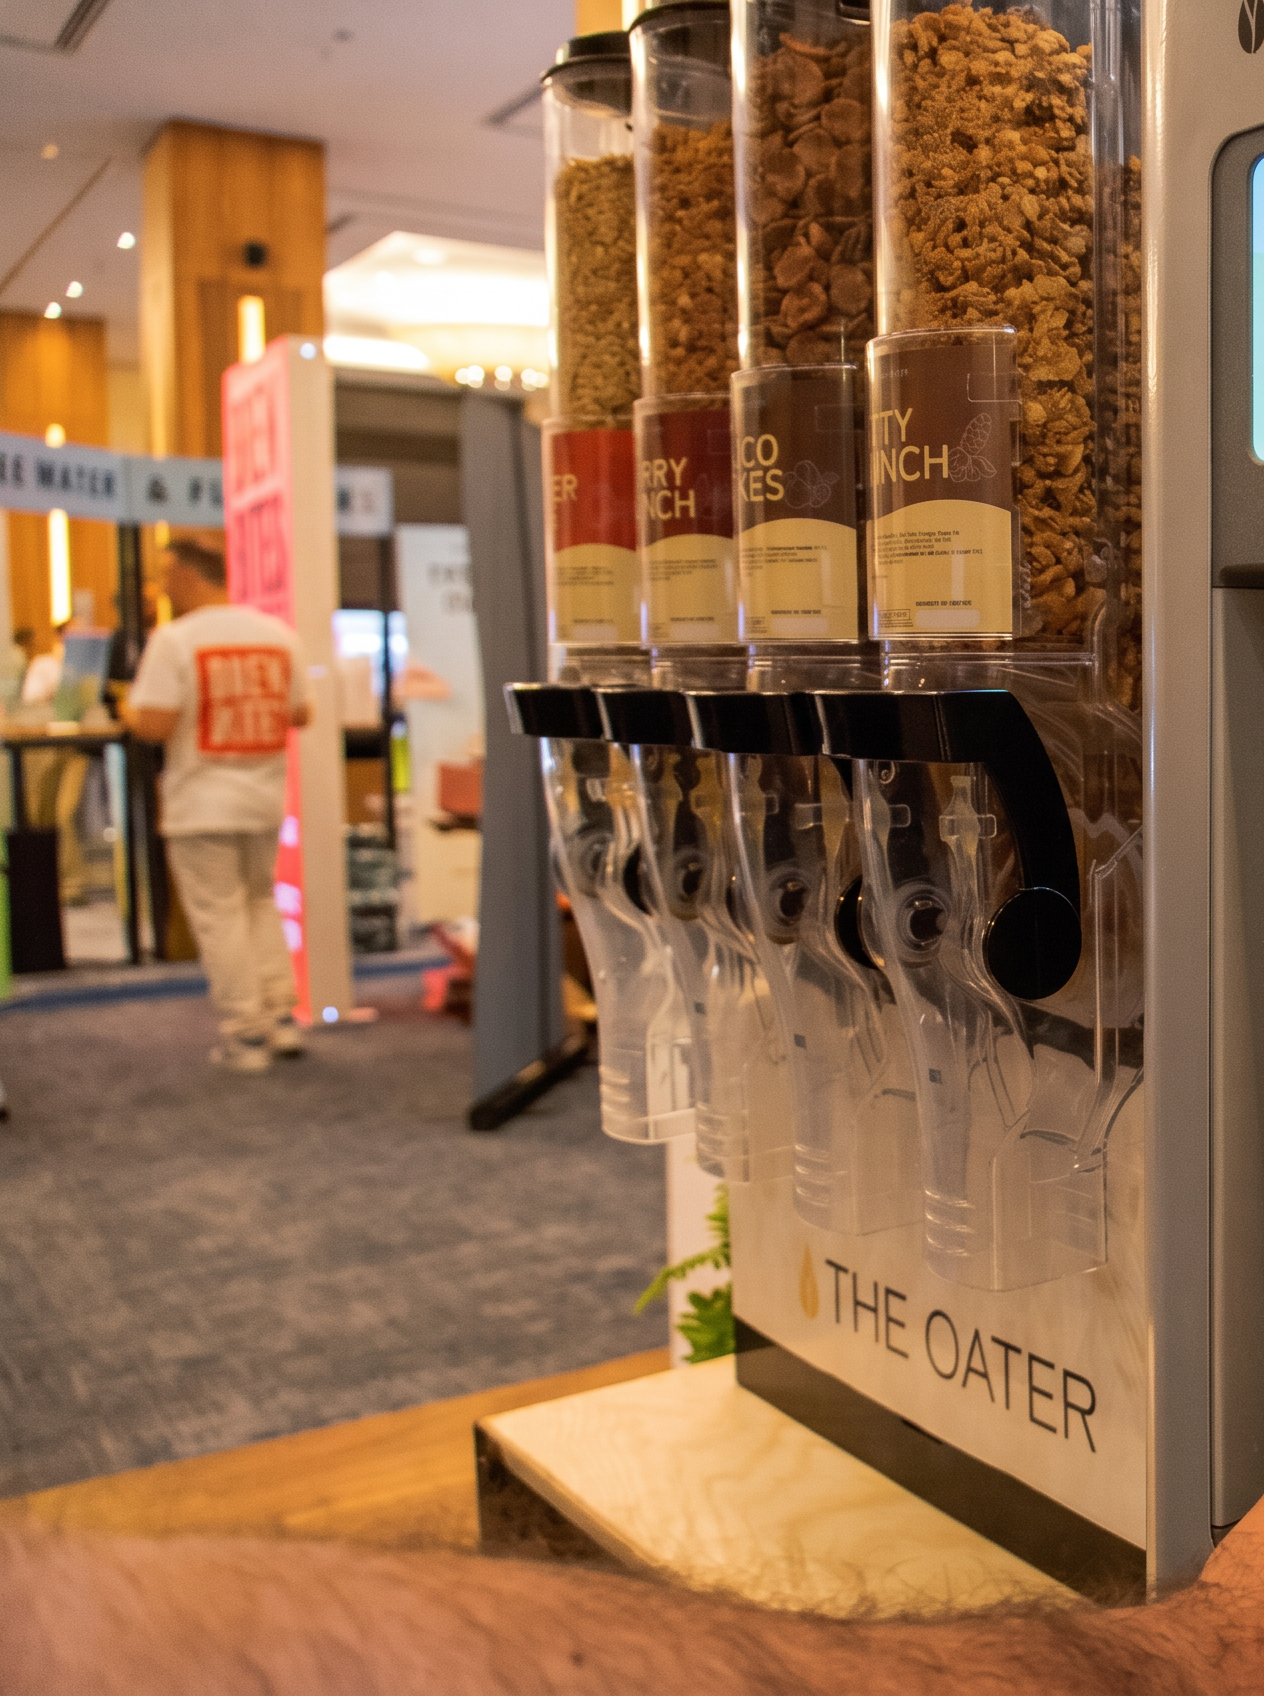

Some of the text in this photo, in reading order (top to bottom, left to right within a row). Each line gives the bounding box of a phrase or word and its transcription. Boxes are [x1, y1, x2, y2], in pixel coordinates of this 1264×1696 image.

[741, 433, 779, 468] CO
[825, 1258, 1097, 1454] THE OATER
